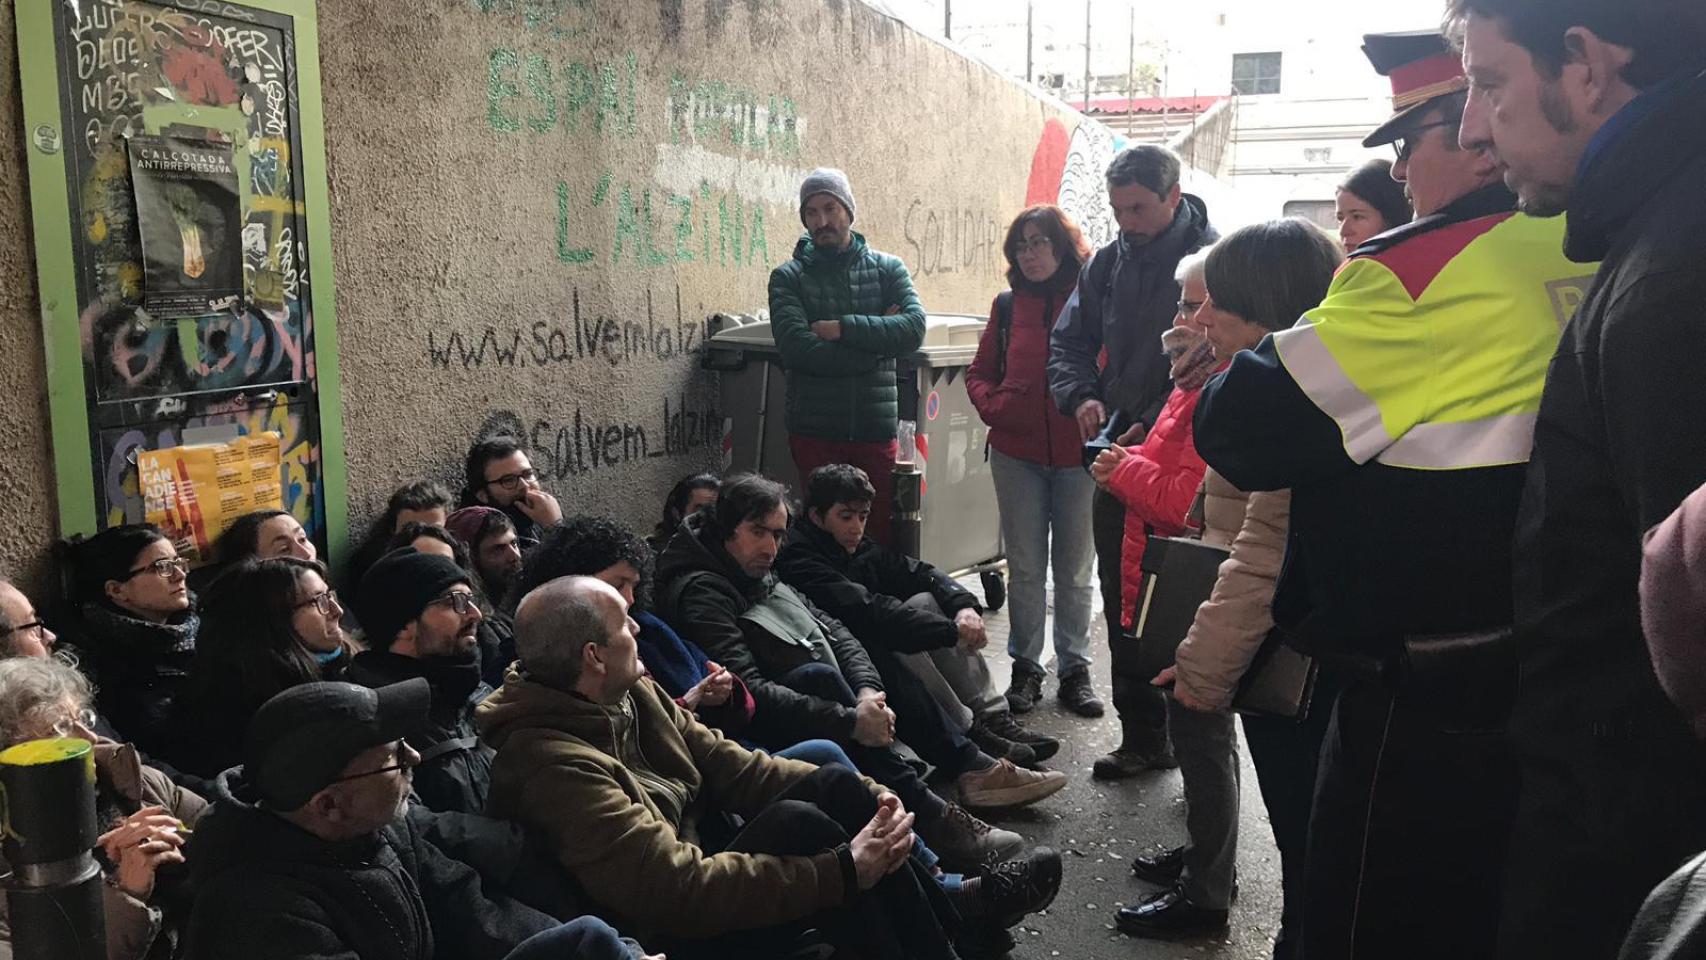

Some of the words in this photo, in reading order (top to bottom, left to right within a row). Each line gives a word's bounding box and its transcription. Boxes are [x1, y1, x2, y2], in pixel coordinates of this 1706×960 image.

[486, 48, 638, 138] ESPAI
[141, 149, 225, 164] CALÇOTADA
[137, 160, 232, 174] ANTIRREPRESSIVA
[556, 169, 770, 268] L'ALZINA
[141, 456, 159, 471] LA
[143, 468, 172, 485] CAN
[145, 481, 177, 498] ADIE
